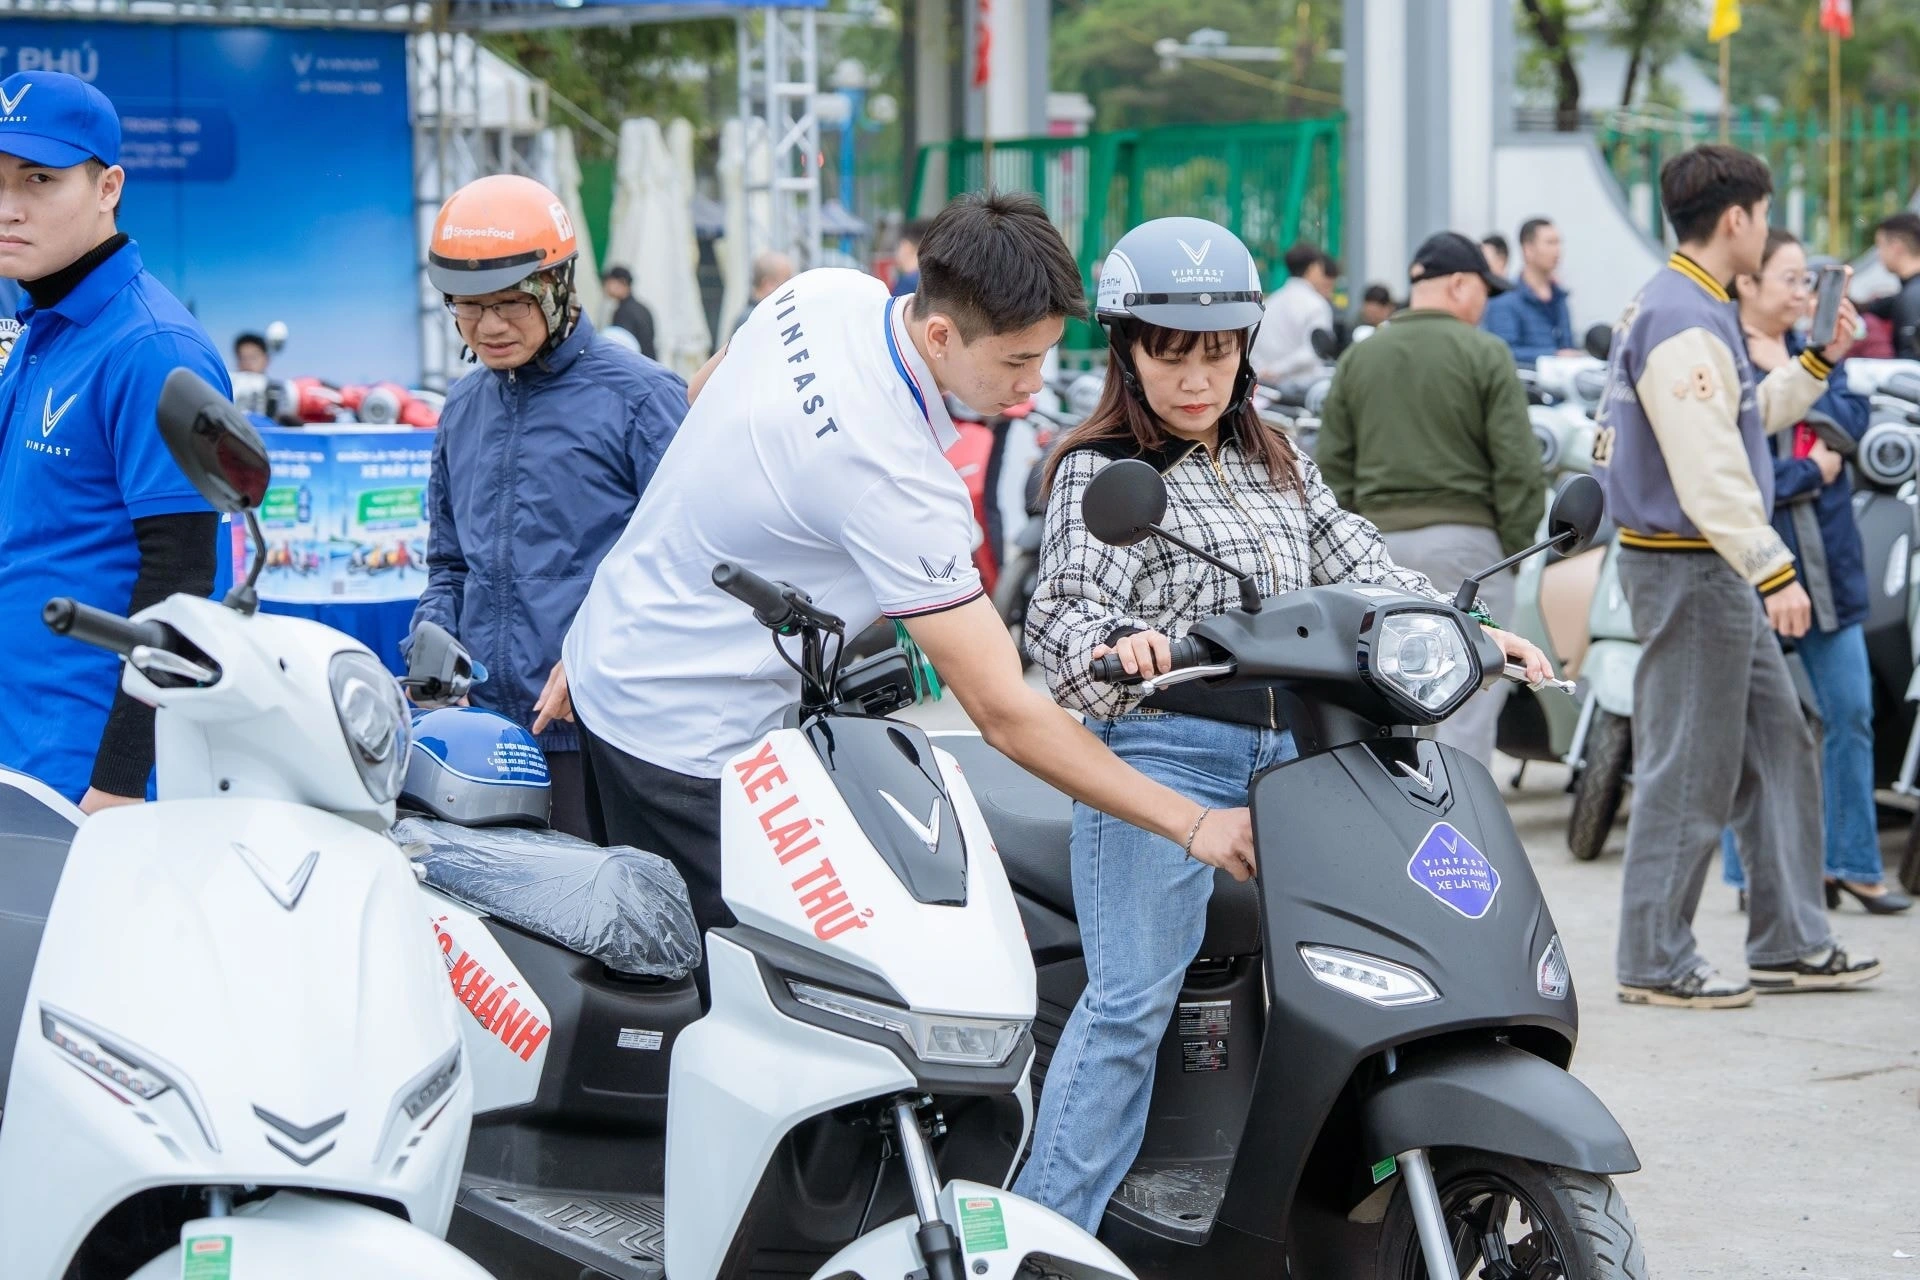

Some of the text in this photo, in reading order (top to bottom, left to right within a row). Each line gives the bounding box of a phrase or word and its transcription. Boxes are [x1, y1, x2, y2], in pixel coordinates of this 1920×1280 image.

[452, 226, 515, 240] ShopeeFood
[1171, 269, 1225, 277] VINFAST
[775, 289, 839, 439] VINFAST
[25, 439, 71, 457] VINFAST
[734, 741, 875, 941] XE LÁI THỬ
[1422, 857, 1484, 868] VINFAST
[1428, 866, 1488, 878] HOÀNG ANH
[1436, 880, 1453, 891] XE
[1454, 877, 1472, 889] LÁI
[449, 951, 551, 1062] KHÁNH
